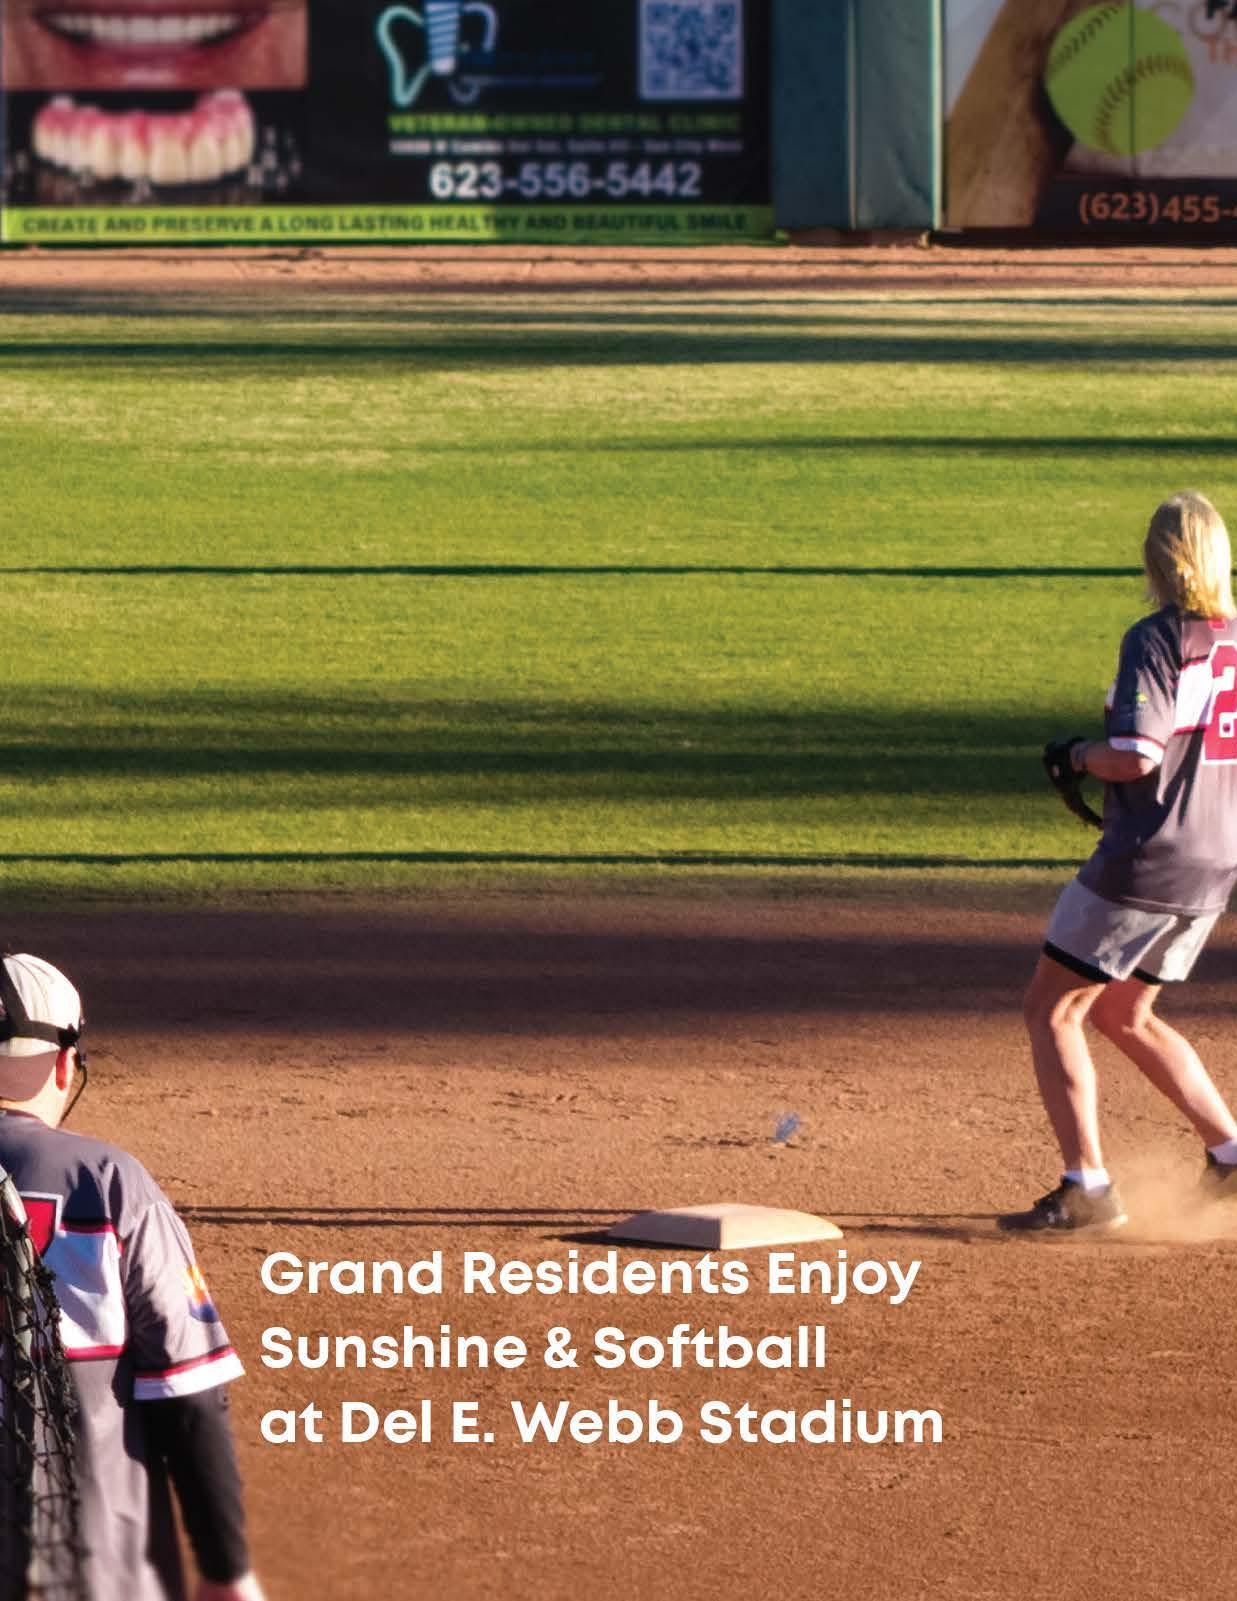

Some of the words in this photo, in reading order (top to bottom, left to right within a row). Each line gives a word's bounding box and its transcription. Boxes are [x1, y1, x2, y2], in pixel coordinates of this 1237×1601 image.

[430, 163, 700, 198] 623-556-5442
[23, 215, 97, 234] CREATE
[104, 216, 147, 234] AND
[152, 215, 253, 233] PRESERVE
[257, 215, 275, 233] A
[278, 215, 335, 232] LONG
[339, 215, 423, 232] LASTING
[430, 214, 520, 231] HEALTHY
[526, 214, 568, 231] AND
[573, 214, 680, 231] BEAUTIFUL
[687, 213, 747, 230] SMILE
